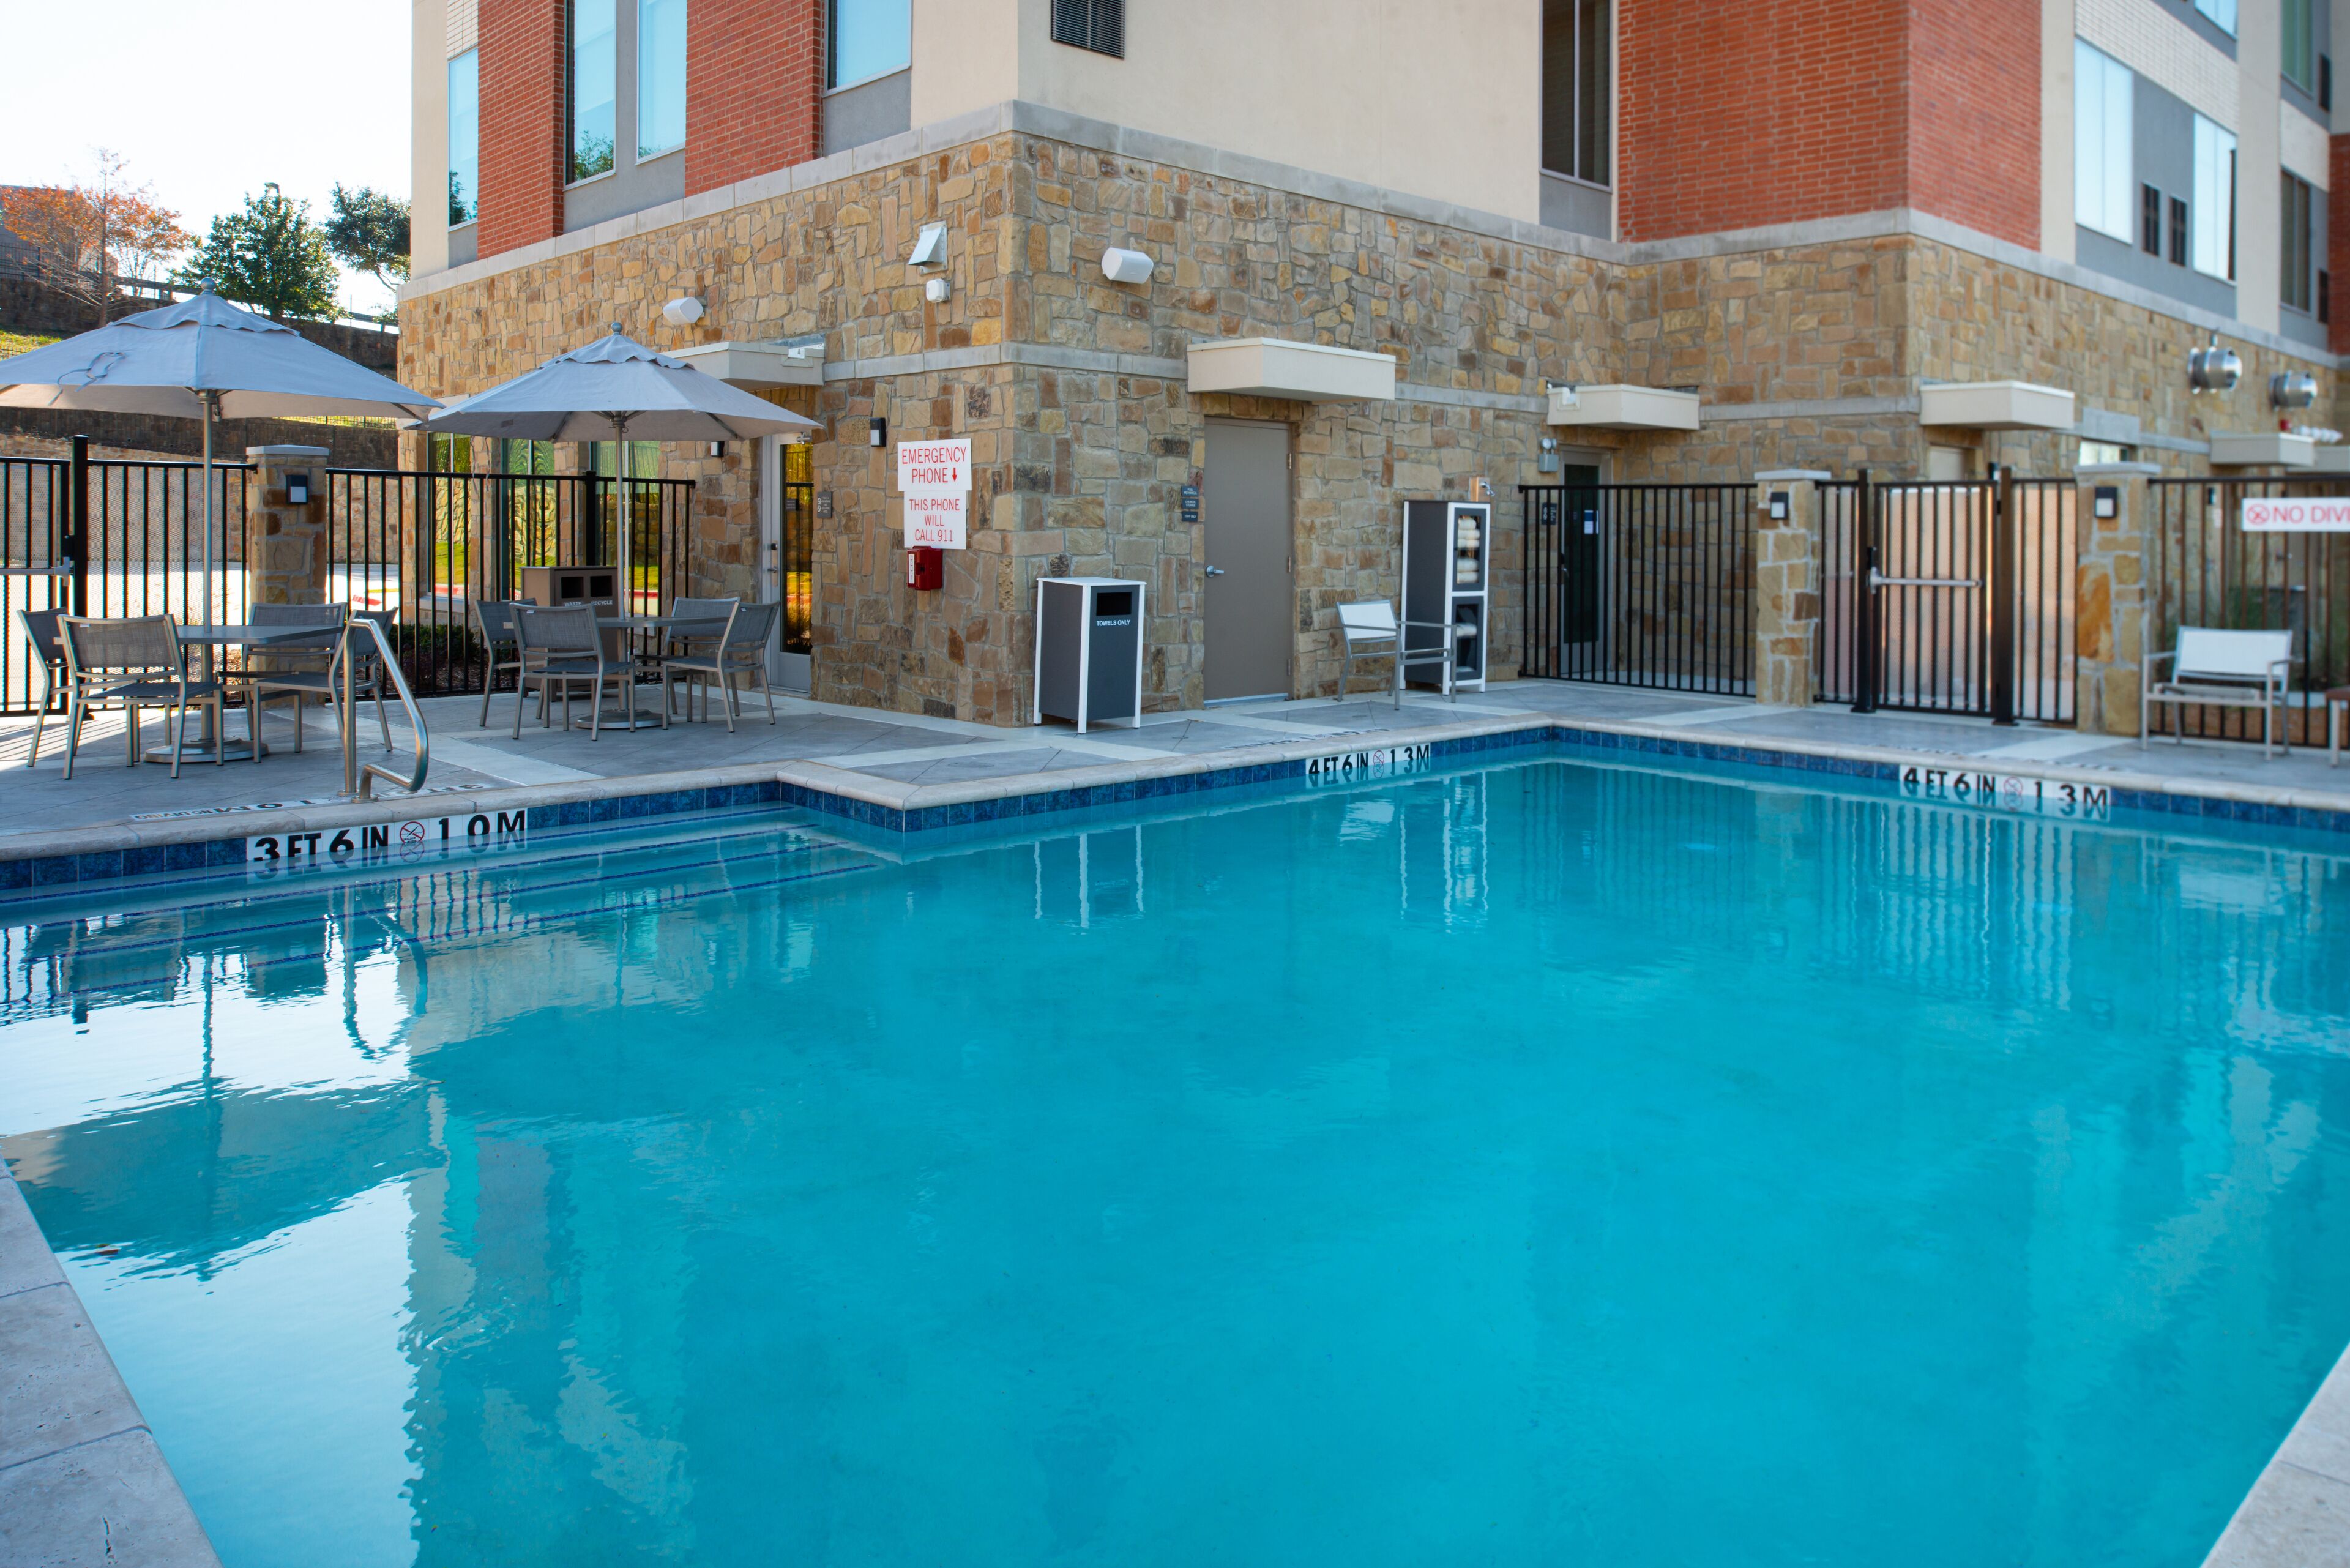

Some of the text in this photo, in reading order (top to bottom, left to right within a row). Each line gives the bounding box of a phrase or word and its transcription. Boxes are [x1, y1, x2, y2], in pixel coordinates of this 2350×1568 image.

[902, 447, 966, 464] EMERGENCY
[912, 468, 948, 483] PHONE
[909, 499, 960, 511] THIS PHONE
[924, 514, 944, 526] WILL
[2273, 506, 2304, 523] NO
[915, 529, 953, 542] CALL 911
